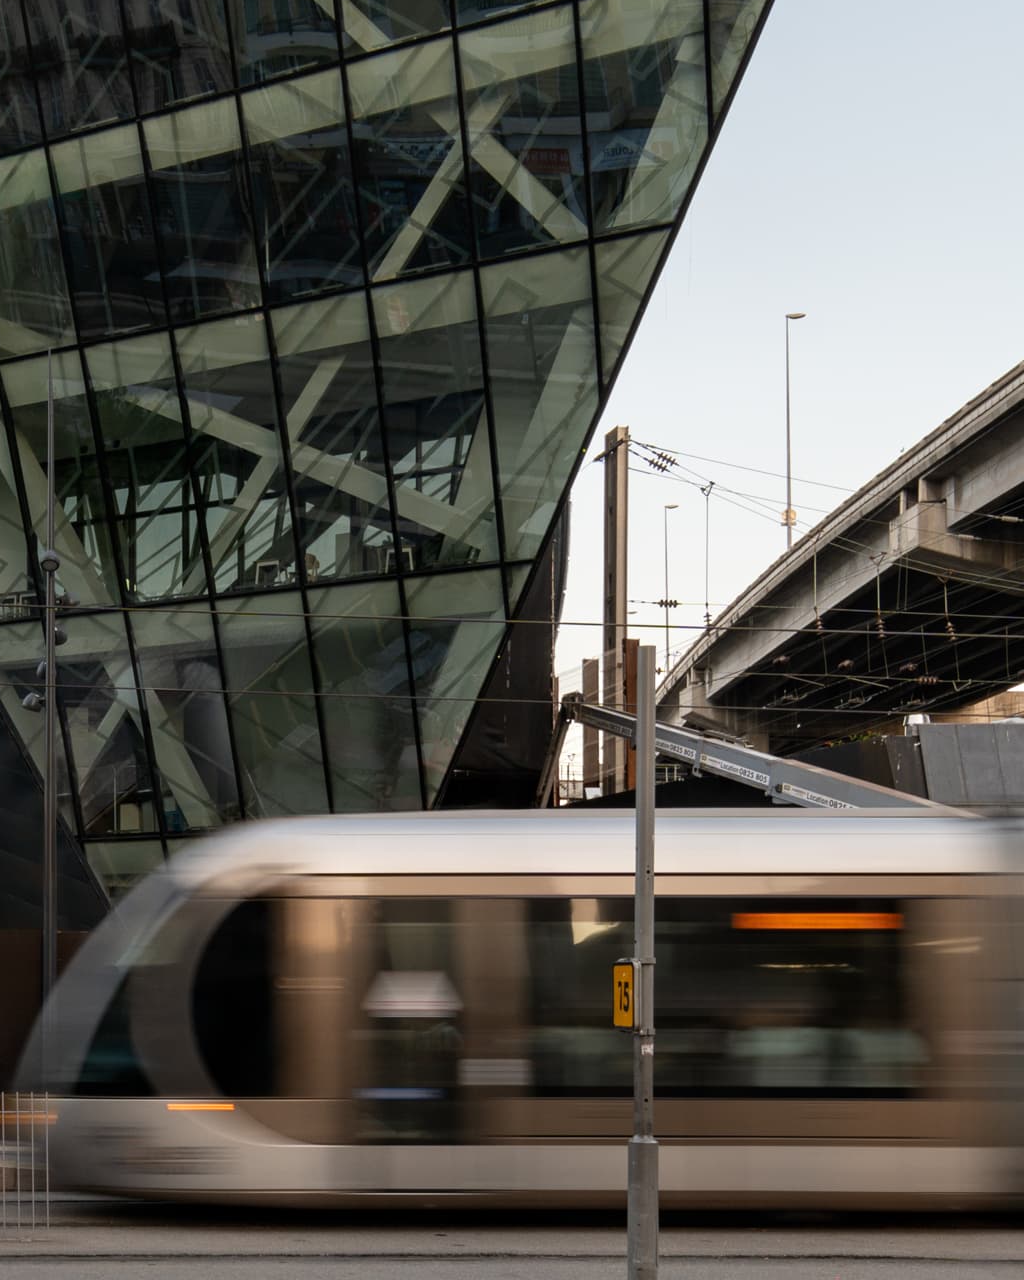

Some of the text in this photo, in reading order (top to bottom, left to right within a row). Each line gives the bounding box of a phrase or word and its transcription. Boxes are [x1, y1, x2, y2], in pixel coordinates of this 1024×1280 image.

[720, 761, 739, 774] Location
[739, 767, 754, 779] 0825
[806, 792, 829, 806] Location
